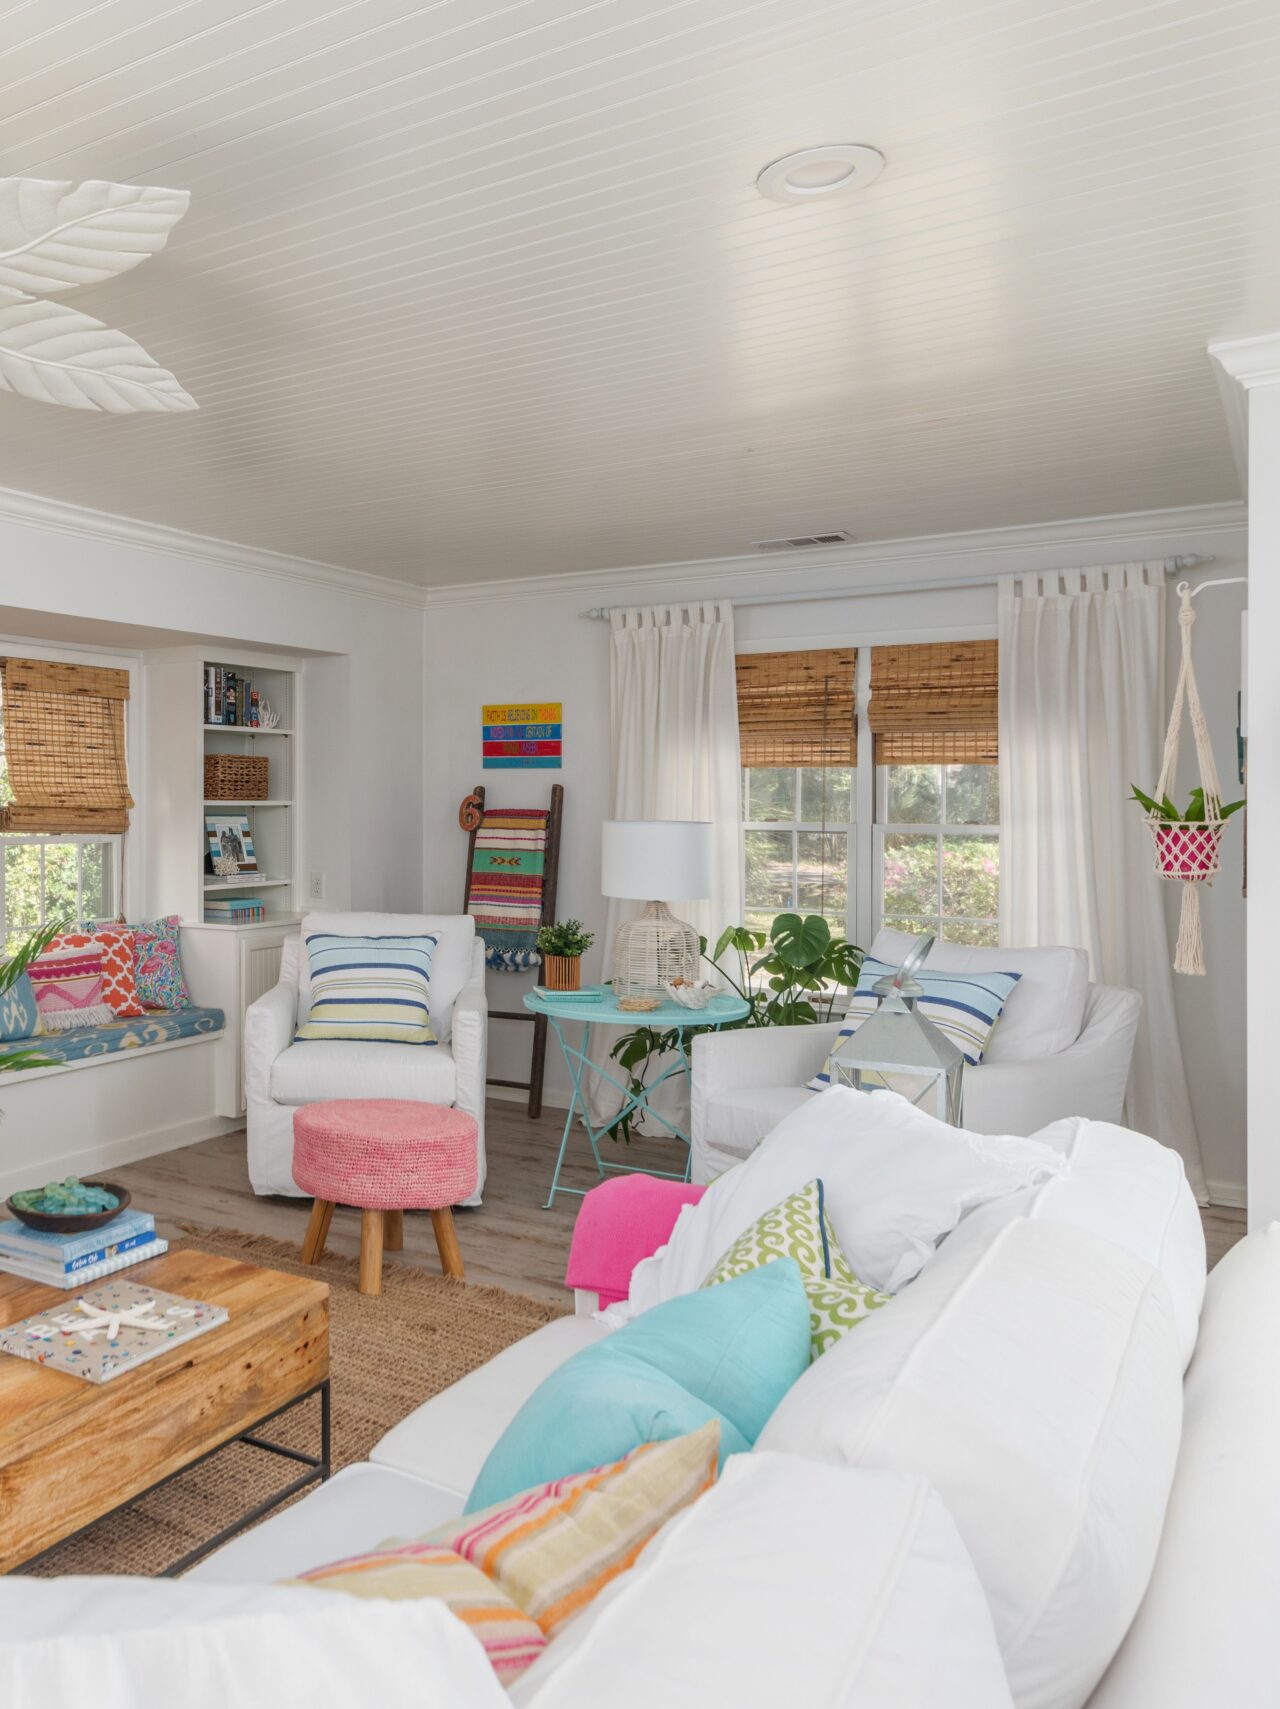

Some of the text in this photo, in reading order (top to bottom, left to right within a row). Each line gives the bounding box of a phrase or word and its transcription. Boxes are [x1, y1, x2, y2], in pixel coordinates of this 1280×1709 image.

[486, 710, 500, 723] FAITH
[501, 710, 507, 722] IS
[508, 709, 530, 722] BELIEVING
[459, 794, 481, 833] 6
